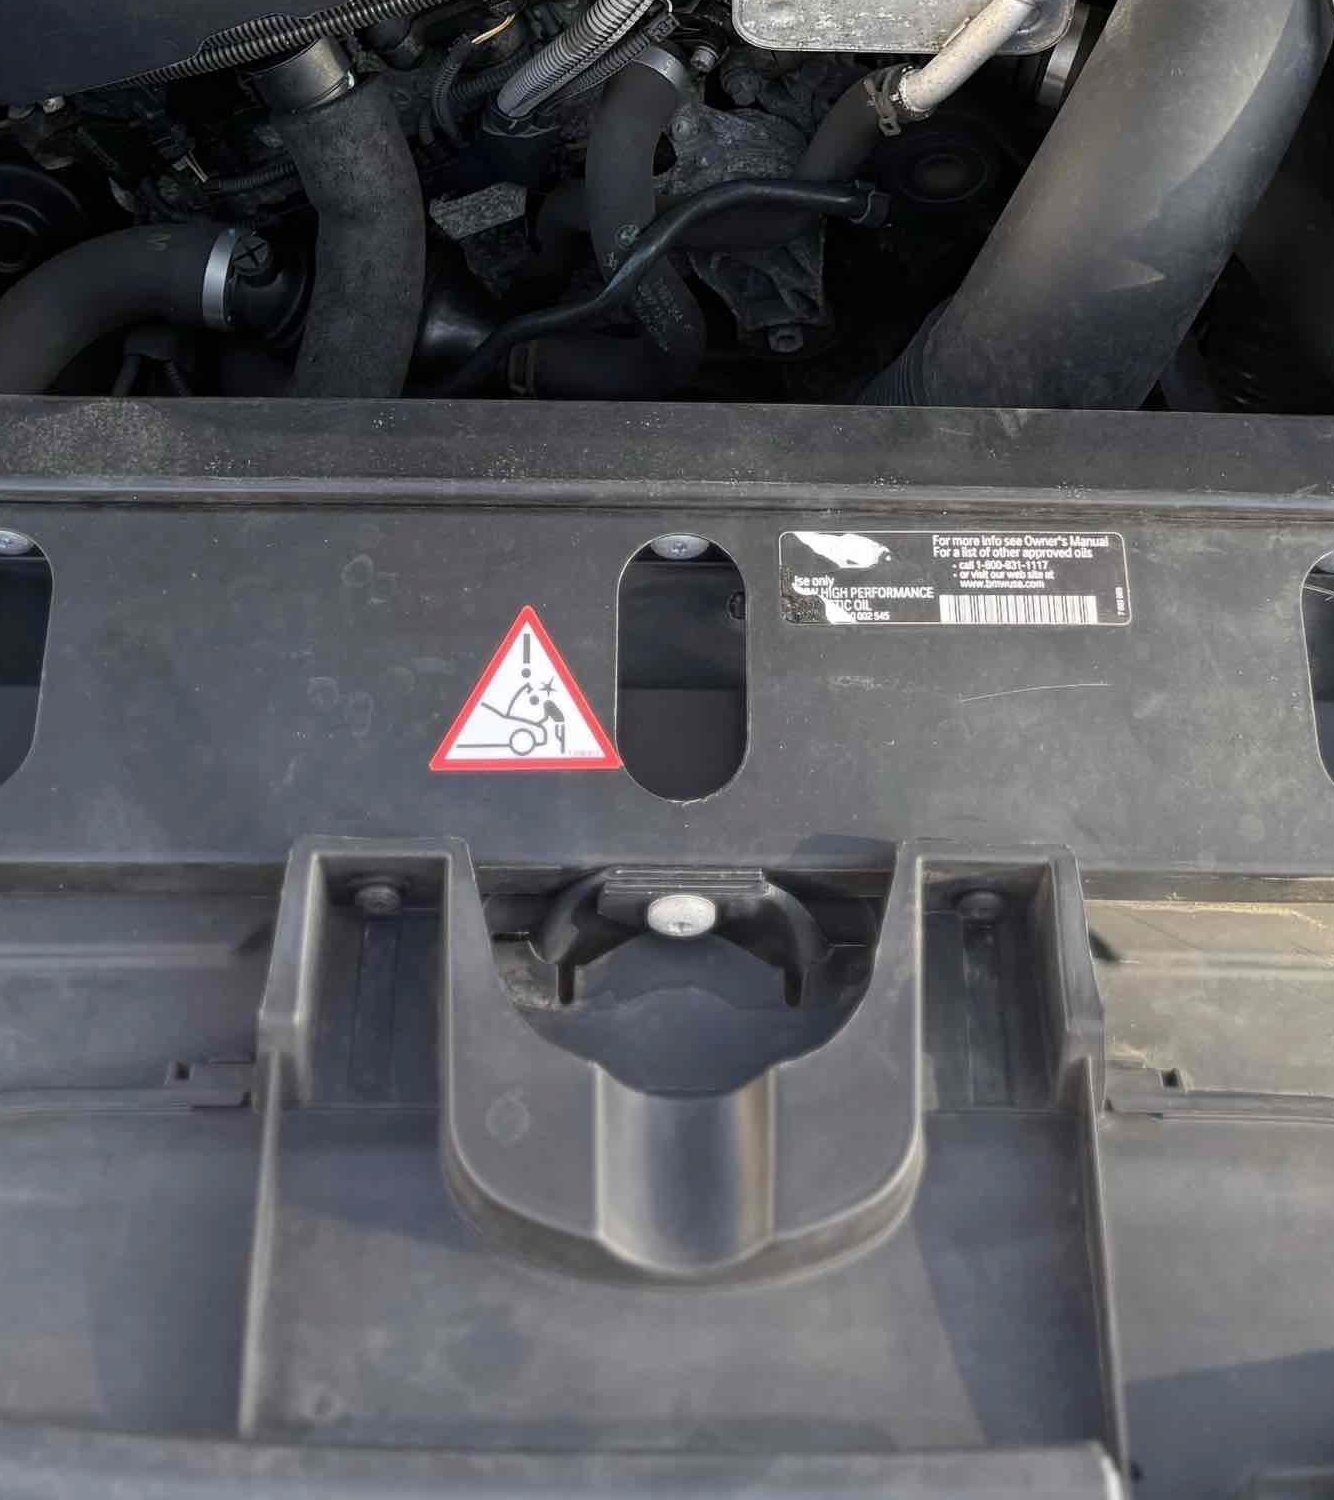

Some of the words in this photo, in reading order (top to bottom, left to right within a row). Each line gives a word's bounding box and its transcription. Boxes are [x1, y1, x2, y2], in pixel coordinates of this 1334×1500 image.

[932, 534, 950, 547] For
[952, 536, 980, 547] more
[981, 534, 1002, 547] info
[1004, 537, 1023, 547] see
[1024, 534, 1068, 547] Owner's
[1069, 535, 1109, 547] Manual
[933, 546, 951, 558] For
[952, 548, 960, 558] a
[961, 546, 977, 558] list
[979, 546, 990, 558] of
[992, 546, 1020, 558] other
[1022, 547, 1072, 560] approved
[1074, 547, 1094, 558] oils
[959, 561, 975, 570] call
[959, 571, 970, 579] or
[990, 571, 1005, 579] our
[812, 575, 835, 590] only
[821, 587, 847, 599] HIGH
[850, 587, 935, 599] PERFORMANCE
[854, 599, 873, 611] OIL
